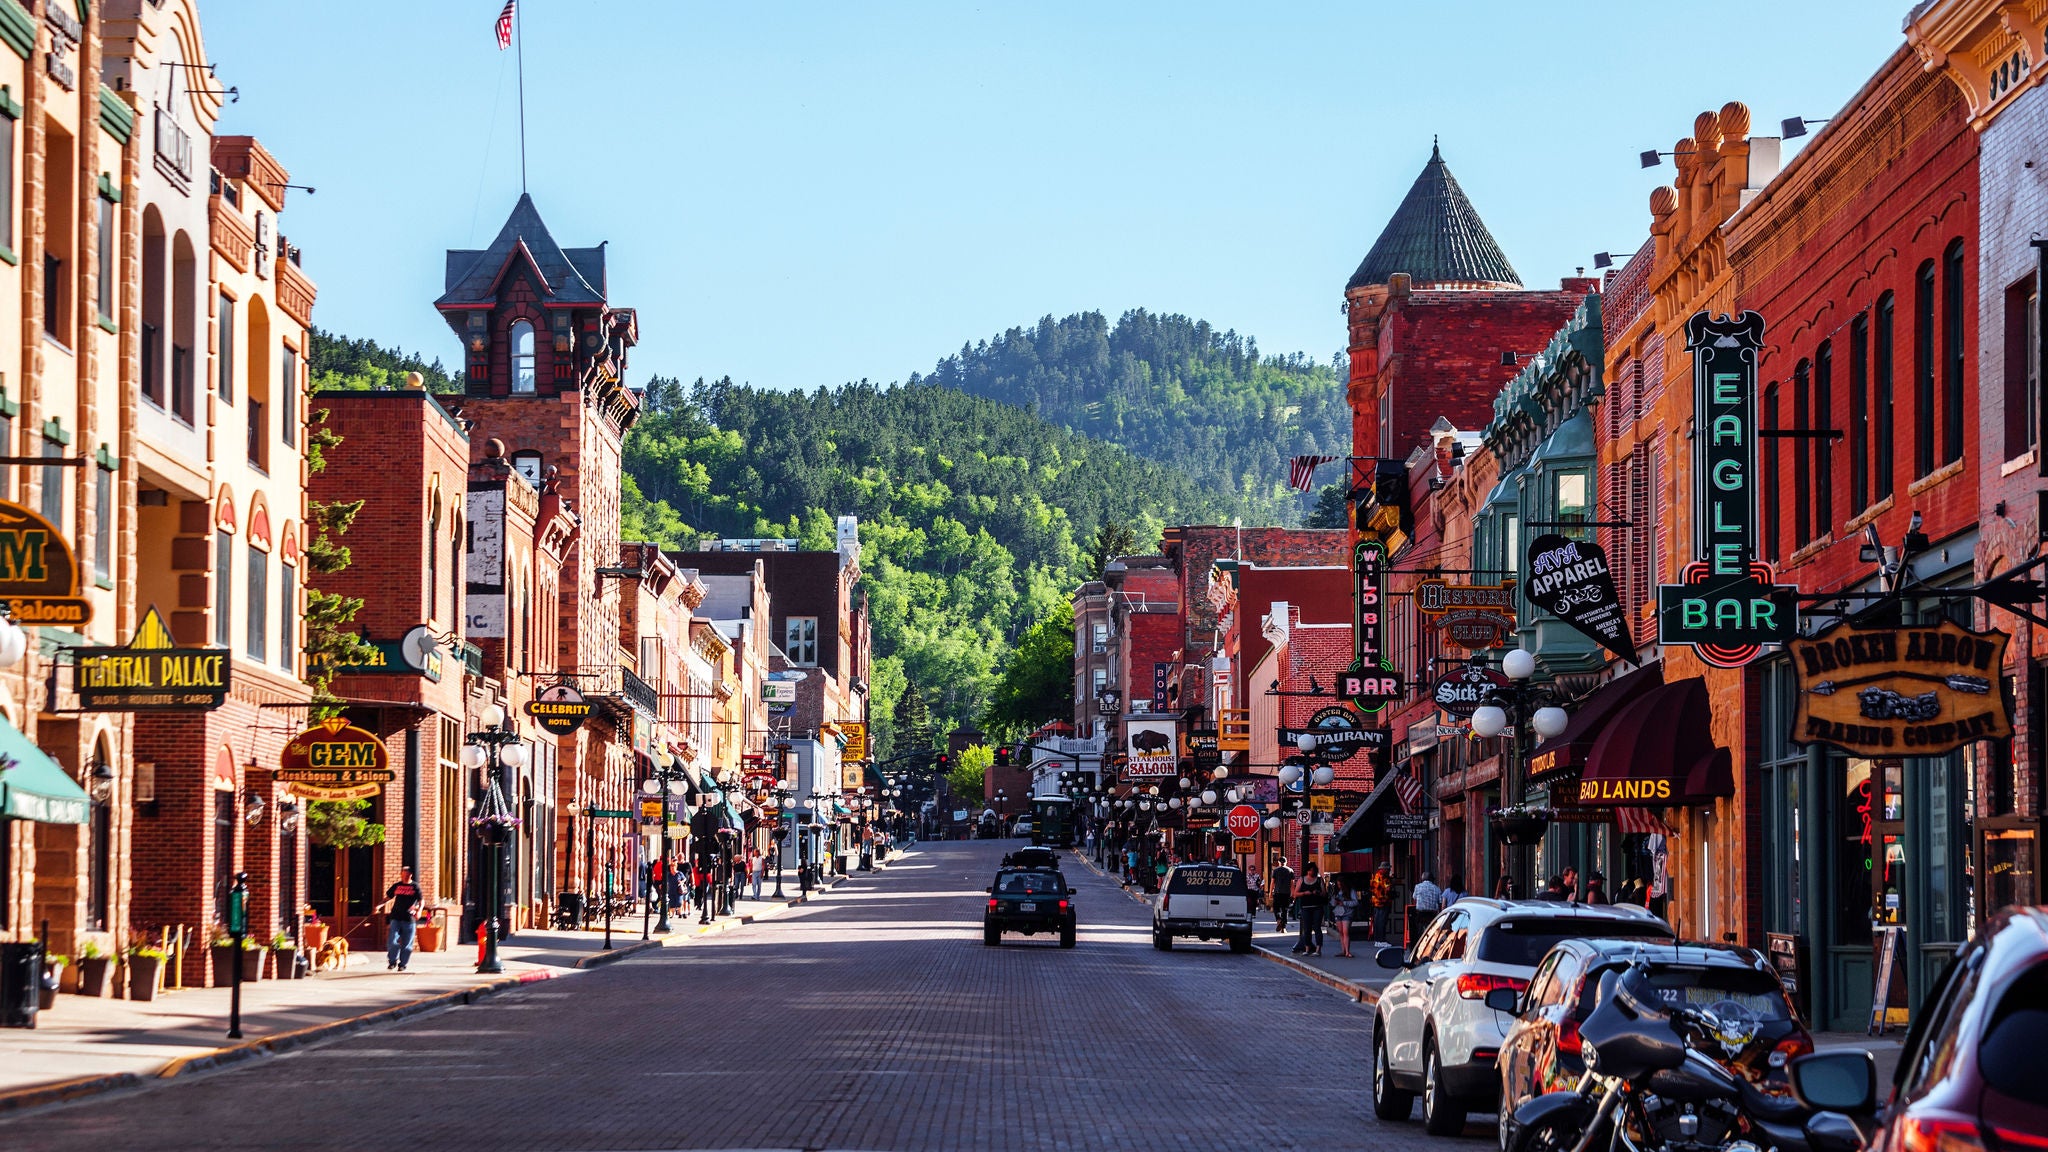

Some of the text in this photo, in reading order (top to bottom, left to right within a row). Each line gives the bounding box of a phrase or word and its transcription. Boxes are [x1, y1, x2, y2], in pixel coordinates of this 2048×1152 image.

[1713, 373, 1743, 575] EAGLE
[1534, 542, 1582, 575] AVA
[1532, 557, 1607, 597] APPAREL
[9, 599, 83, 621] Saloon
[1682, 598, 1778, 630] BAR
[1453, 625, 1493, 640] CLUB
[1602, 625, 1618, 635] BIKER
[1363, 612, 1378, 668] BILL
[1801, 631, 1995, 677] BROKEN ARROW
[80, 655, 224, 688] MINERAL PALACE
[1346, 677, 1398, 696] BAR
[1435, 681, 1478, 704] Sick
[127, 694, 175, 705] ROULETTE
[183, 694, 214, 704] CARDS
[530, 702, 591, 716] CELEBRITY
[1100, 703, 1120, 711] ELKS
[548, 718, 572, 726] HOTEL
[1314, 708, 1358, 724] OYSTER BAY
[1806, 711, 1998, 747] TRADING COMPANY
[309, 741, 377, 768] GEM
[1321, 750, 1350, 761] GAMING
[277, 770, 391, 781] Steakhouse & Saloon
[1129, 762, 1176, 775] SALOON
[1580, 779, 1671, 800] BAD LANDS
[1230, 815, 1258, 828] STOP
[1186, 877, 1232, 886] 920-2020
